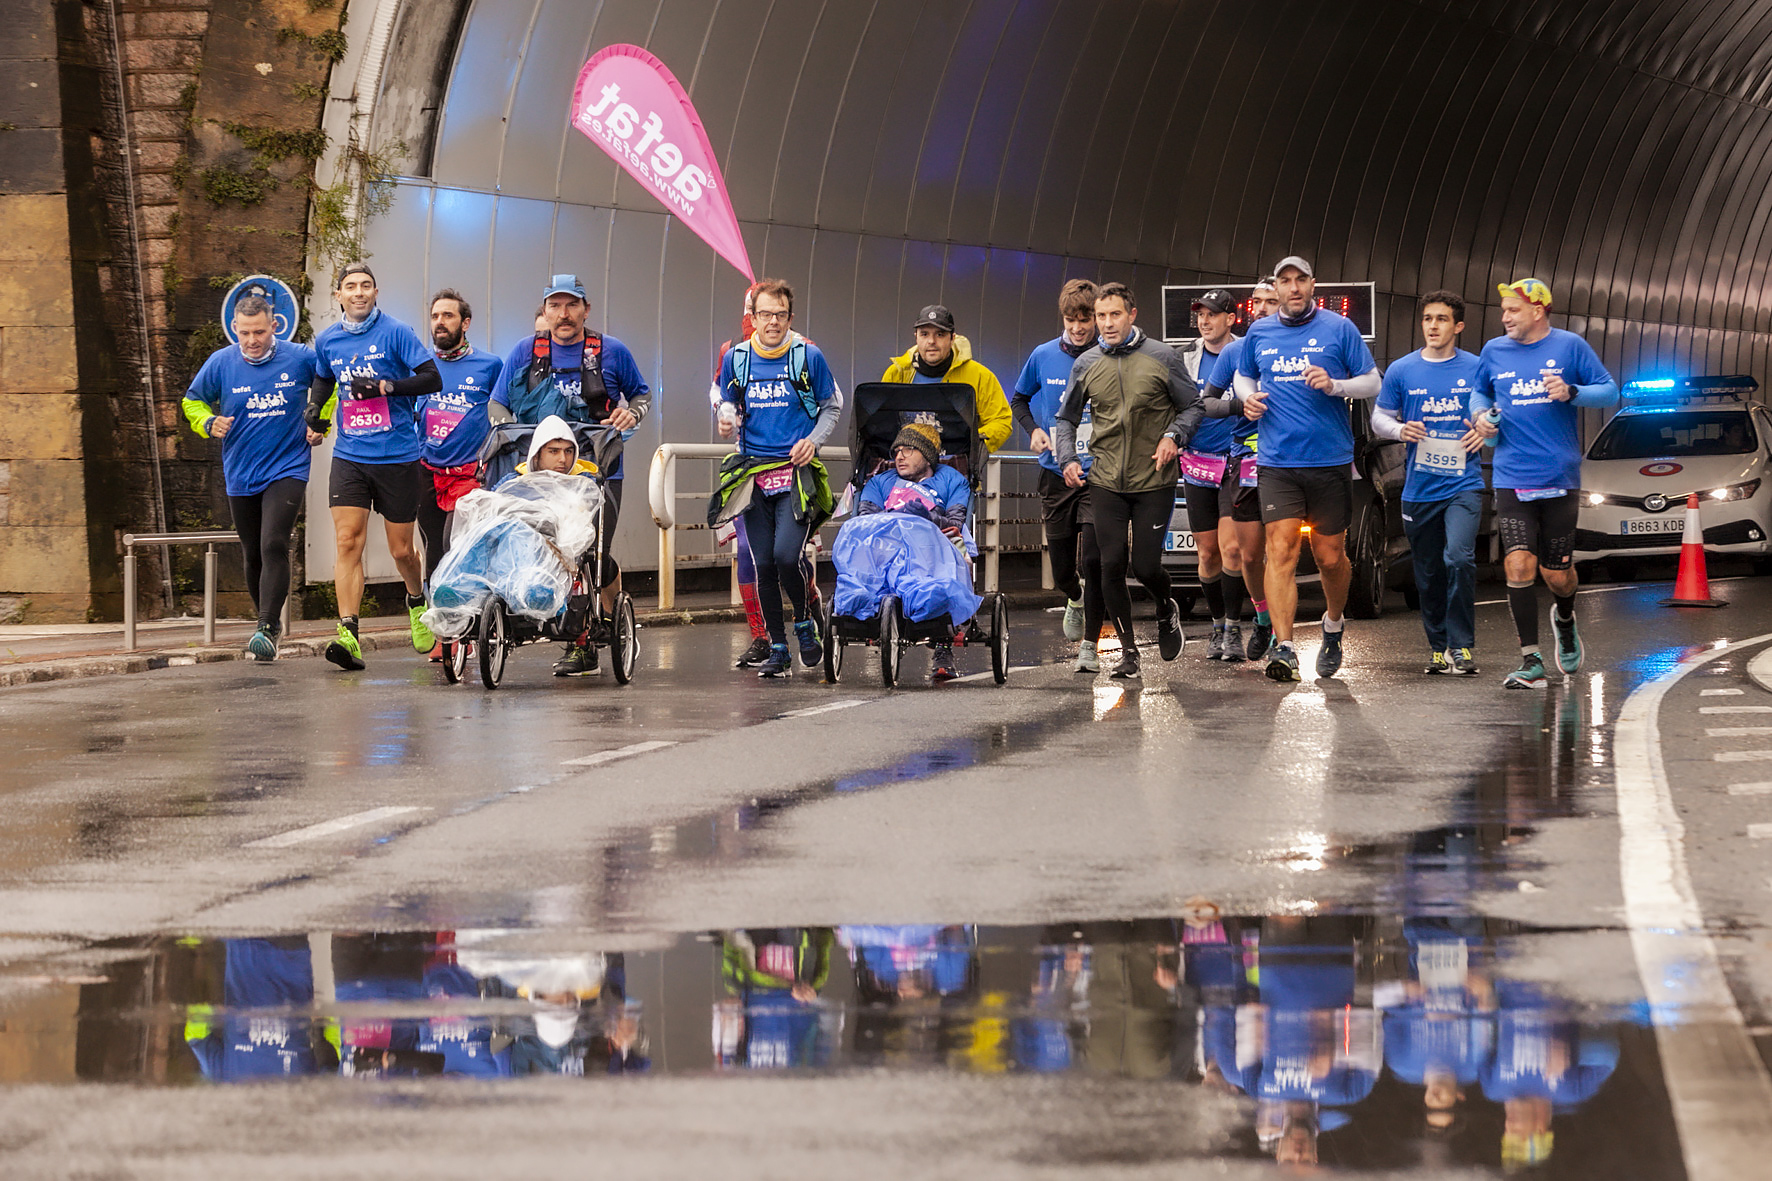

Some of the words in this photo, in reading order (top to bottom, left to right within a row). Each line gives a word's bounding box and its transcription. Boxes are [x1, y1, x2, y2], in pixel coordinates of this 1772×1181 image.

[363, 351, 386, 361] ZURICH
[274, 380, 296, 389] ZURICH
[458, 384, 482, 392] ZURICH
[447, 405, 467, 413] ZURICH
[750, 400, 789, 409] #Imparables
[248, 409, 286, 419] #Imparables
[350, 413, 382, 427] 2630
[432, 424, 455, 438] 26
[1438, 431, 1458, 439] ZURICH
[1424, 452, 1458, 466] 3595
[1186, 464, 1216, 481] 2633
[764, 475, 792, 490] 257
[1630, 520, 1660, 533] 8663
[1663, 519, 1685, 532] KDB
